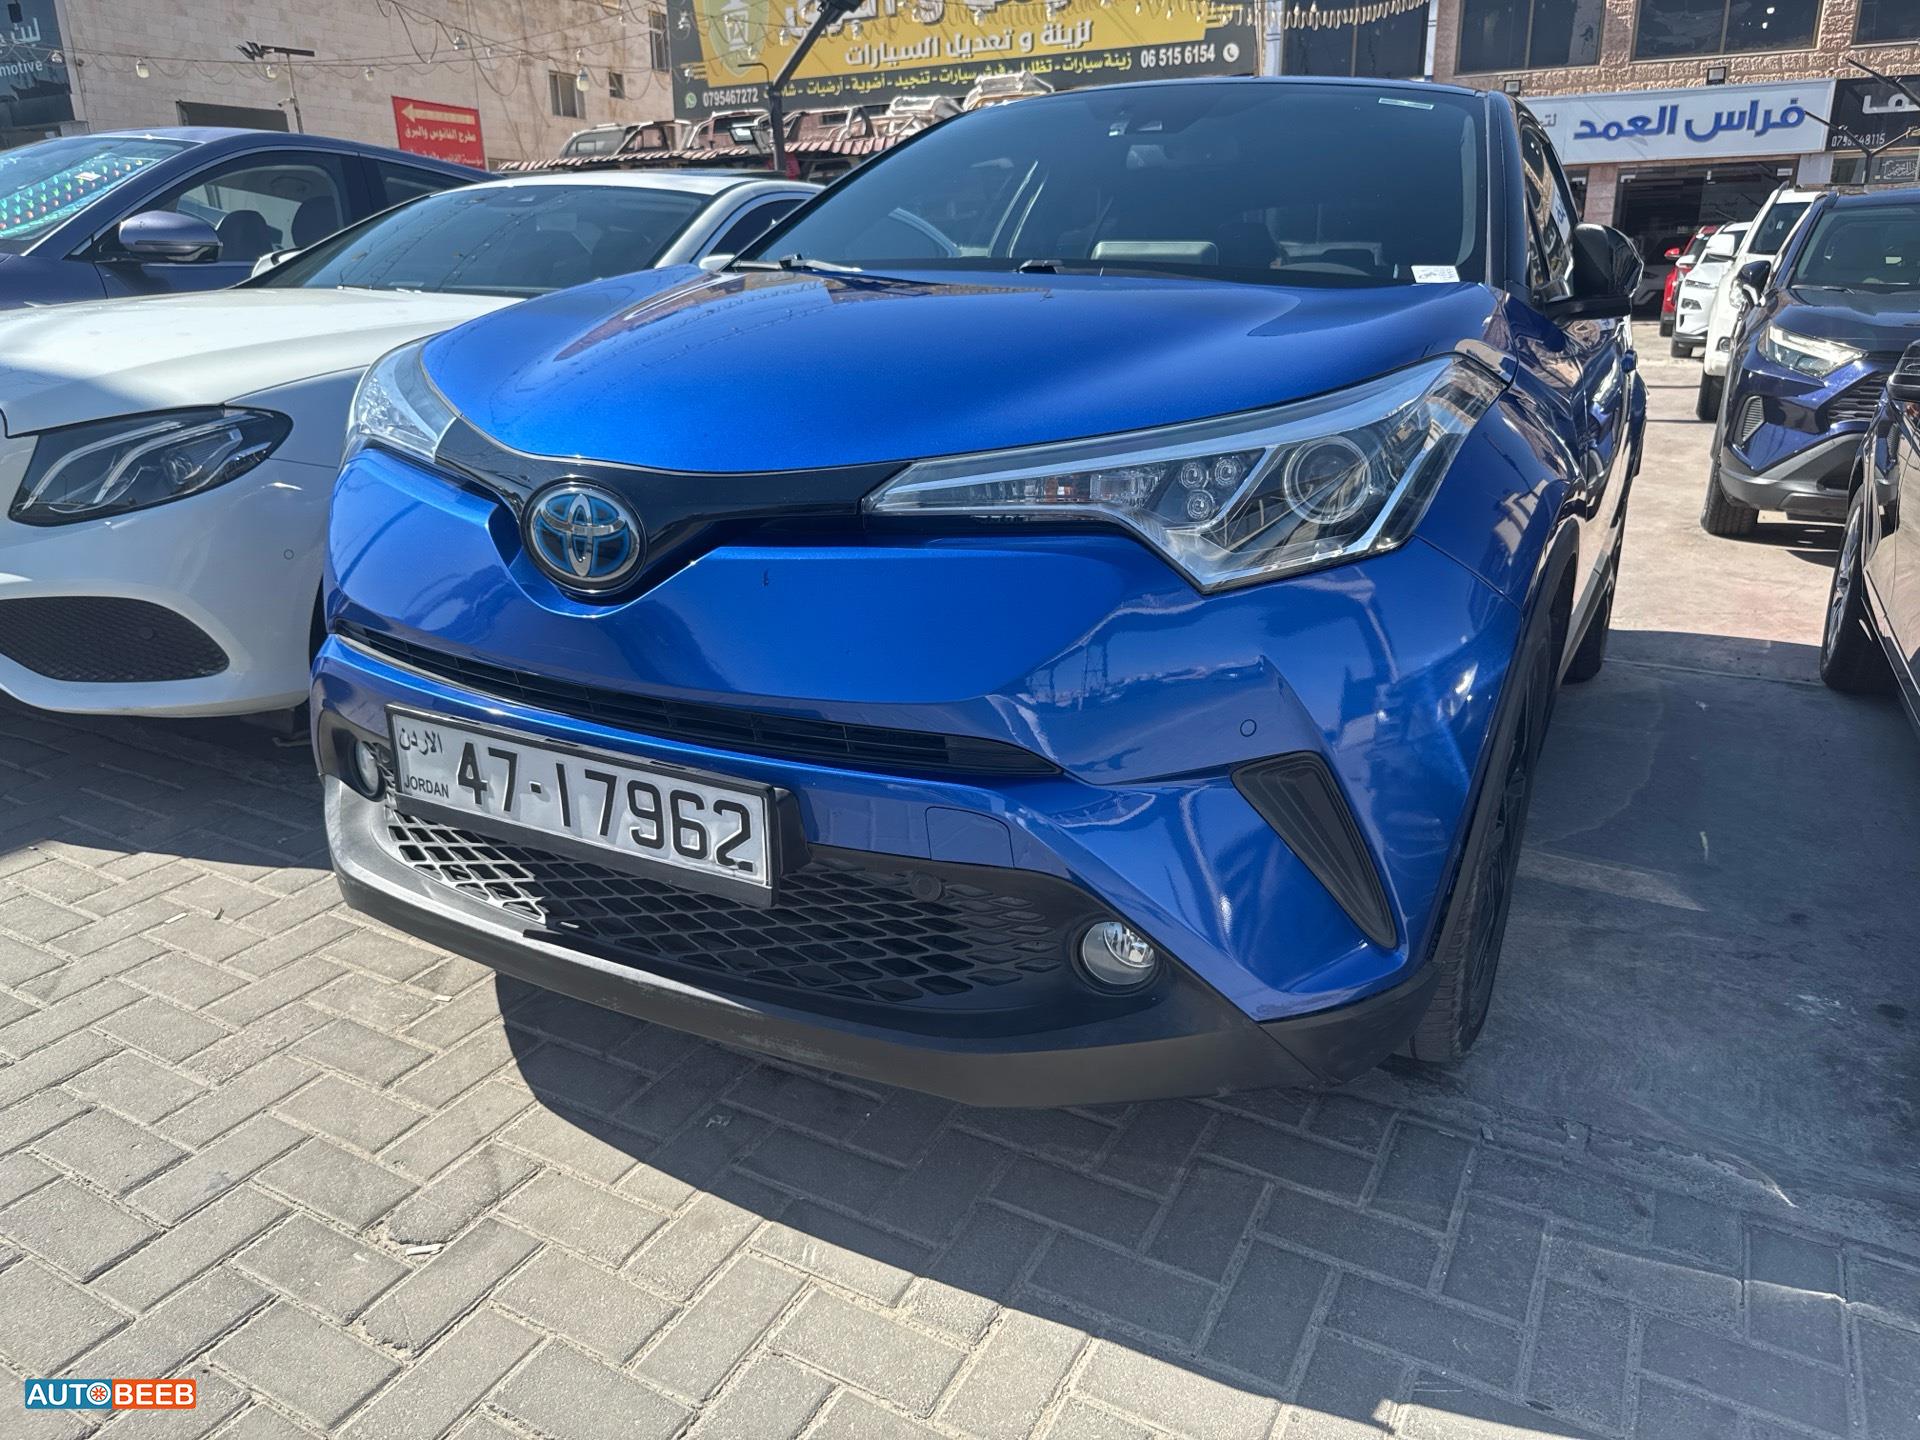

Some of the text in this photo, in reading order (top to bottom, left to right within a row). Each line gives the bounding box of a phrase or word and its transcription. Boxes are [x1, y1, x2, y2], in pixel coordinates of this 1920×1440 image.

[845, 37, 940, 68] السيارات
[946, 29, 1014, 60] تعديل
[1019, 30, 1035, 53] و
[1062, 56, 1103, 74] سيارات
[1104, 50, 1132, 72] زينة
[1140, 43, 1216, 68] 06 515 6154
[851, 72, 885, 94] أضوية
[894, 70, 931, 90] تنجيد
[939, 66, 976, 85] سيارات
[702, 87, 759, 107] 0795467272
[807, 77, 843, 97] أرضيات
[1572, 97, 1807, 143] فراس العمد
[403, 774, 450, 799] JORDAN
